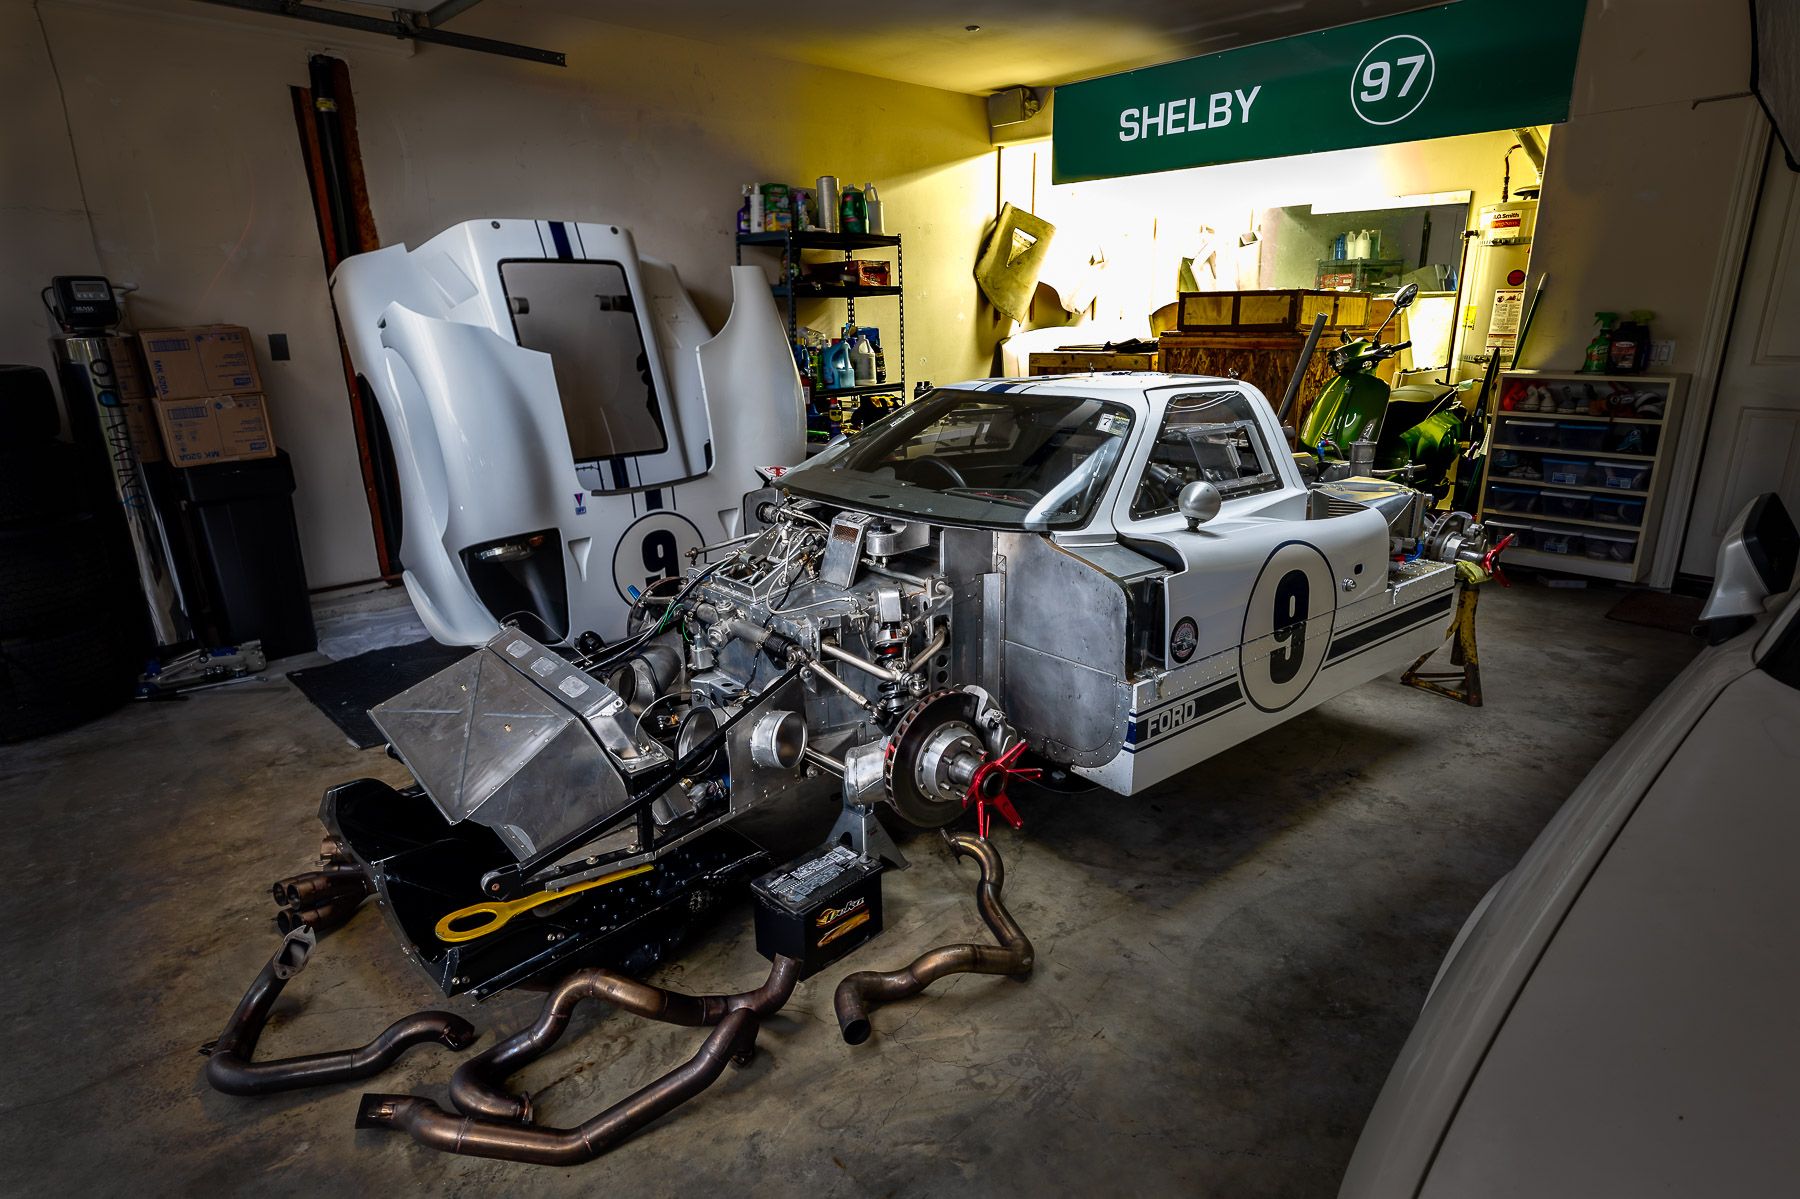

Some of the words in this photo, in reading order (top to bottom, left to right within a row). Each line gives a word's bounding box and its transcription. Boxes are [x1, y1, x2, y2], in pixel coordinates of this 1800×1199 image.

[1360, 54, 1426, 103] 97
[1119, 85, 1262, 142] SHELBY
[642, 529, 680, 588] 9
[1270, 569, 1309, 684] 9
[1147, 700, 1196, 739] FORD
